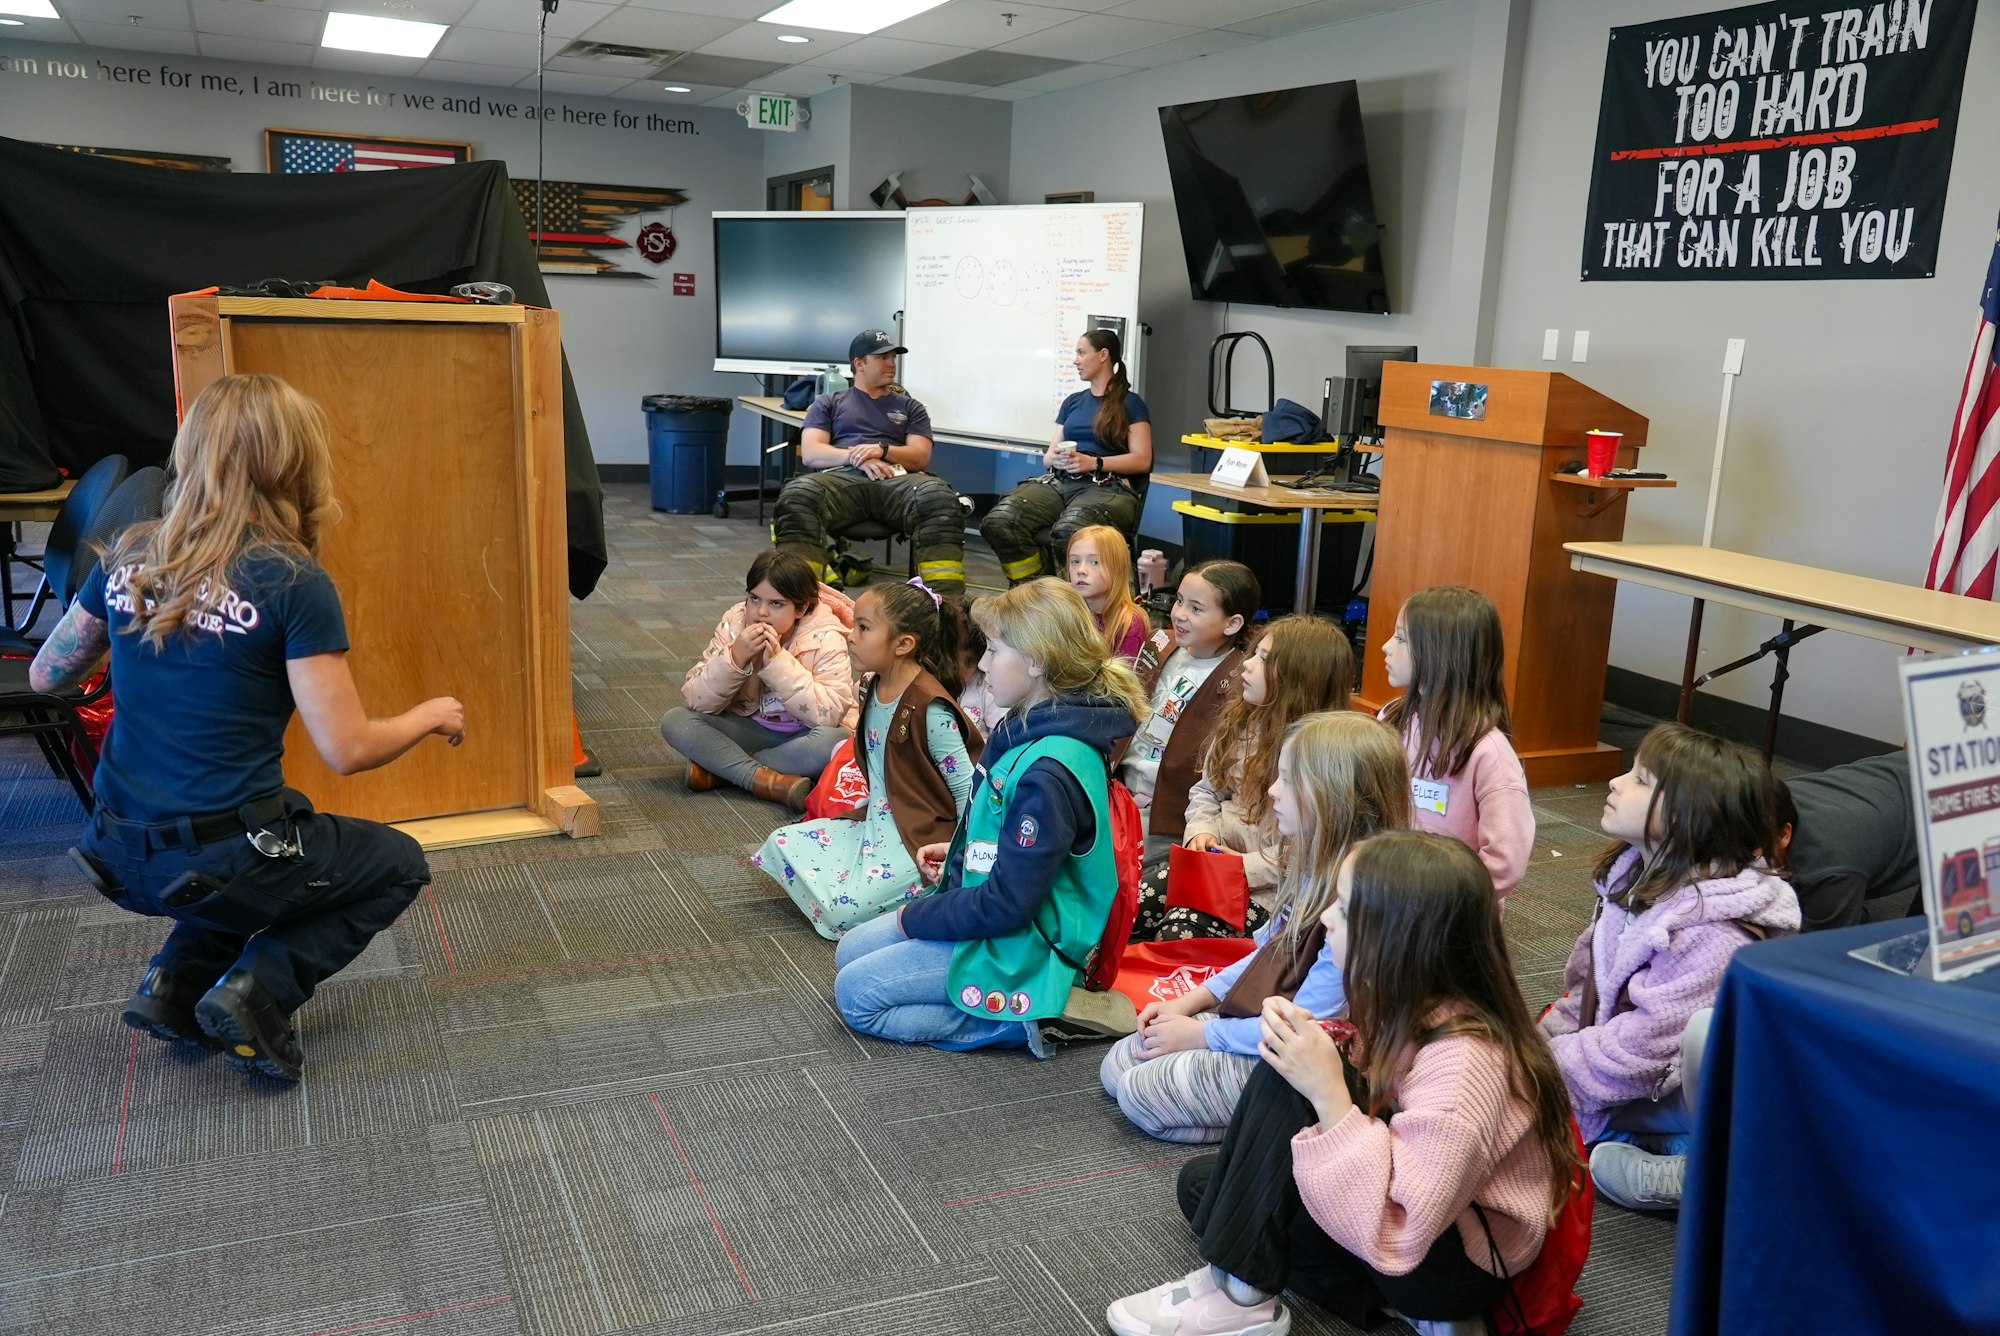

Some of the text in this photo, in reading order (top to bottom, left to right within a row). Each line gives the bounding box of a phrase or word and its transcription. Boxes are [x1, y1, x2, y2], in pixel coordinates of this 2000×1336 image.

[1645, 0, 1933, 88] YOU CAN'T TRAIN
[47, 60, 88, 79] not
[96, 59, 151, 85] here
[160, 66, 192, 88] for
[201, 73, 243, 95] me,
[253, 76, 259, 94] I
[267, 80, 301, 98] am
[310, 80, 360, 103] here
[366, 86, 396, 107] for
[403, 92, 435, 111] we
[442, 96, 481, 115] and
[488, 102, 518, 119] we
[562, 104, 606, 127] here
[613, 109, 639, 130] for
[647, 113, 700, 136] them.
[759, 97, 791, 126] EXIT
[1675, 62, 1867, 144] TOO HARD
[1654, 146, 1857, 217] FOR A JOB
[1602, 208, 1915, 268] THAT CAN KILL YOU
[1928, 736, 2000, 776] STATIO
[1413, 784, 1440, 801] ELLIE
[1929, 792, 1963, 817] HOME
[1963, 785, 1991, 809] FIRE
